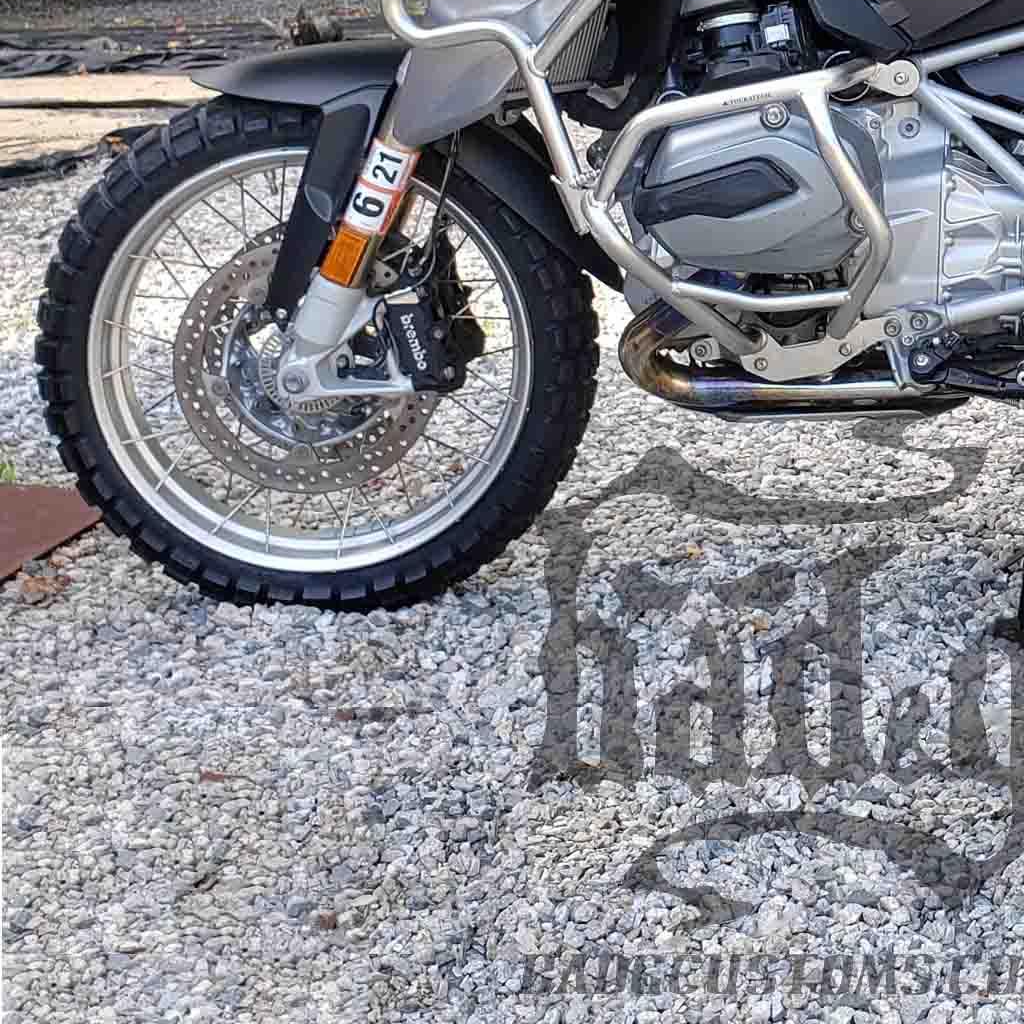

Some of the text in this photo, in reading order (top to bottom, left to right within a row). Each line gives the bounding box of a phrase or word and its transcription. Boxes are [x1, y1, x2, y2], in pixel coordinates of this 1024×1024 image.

[352, 151, 404, 218] 6 21
[400, 312, 428, 371] brembo
